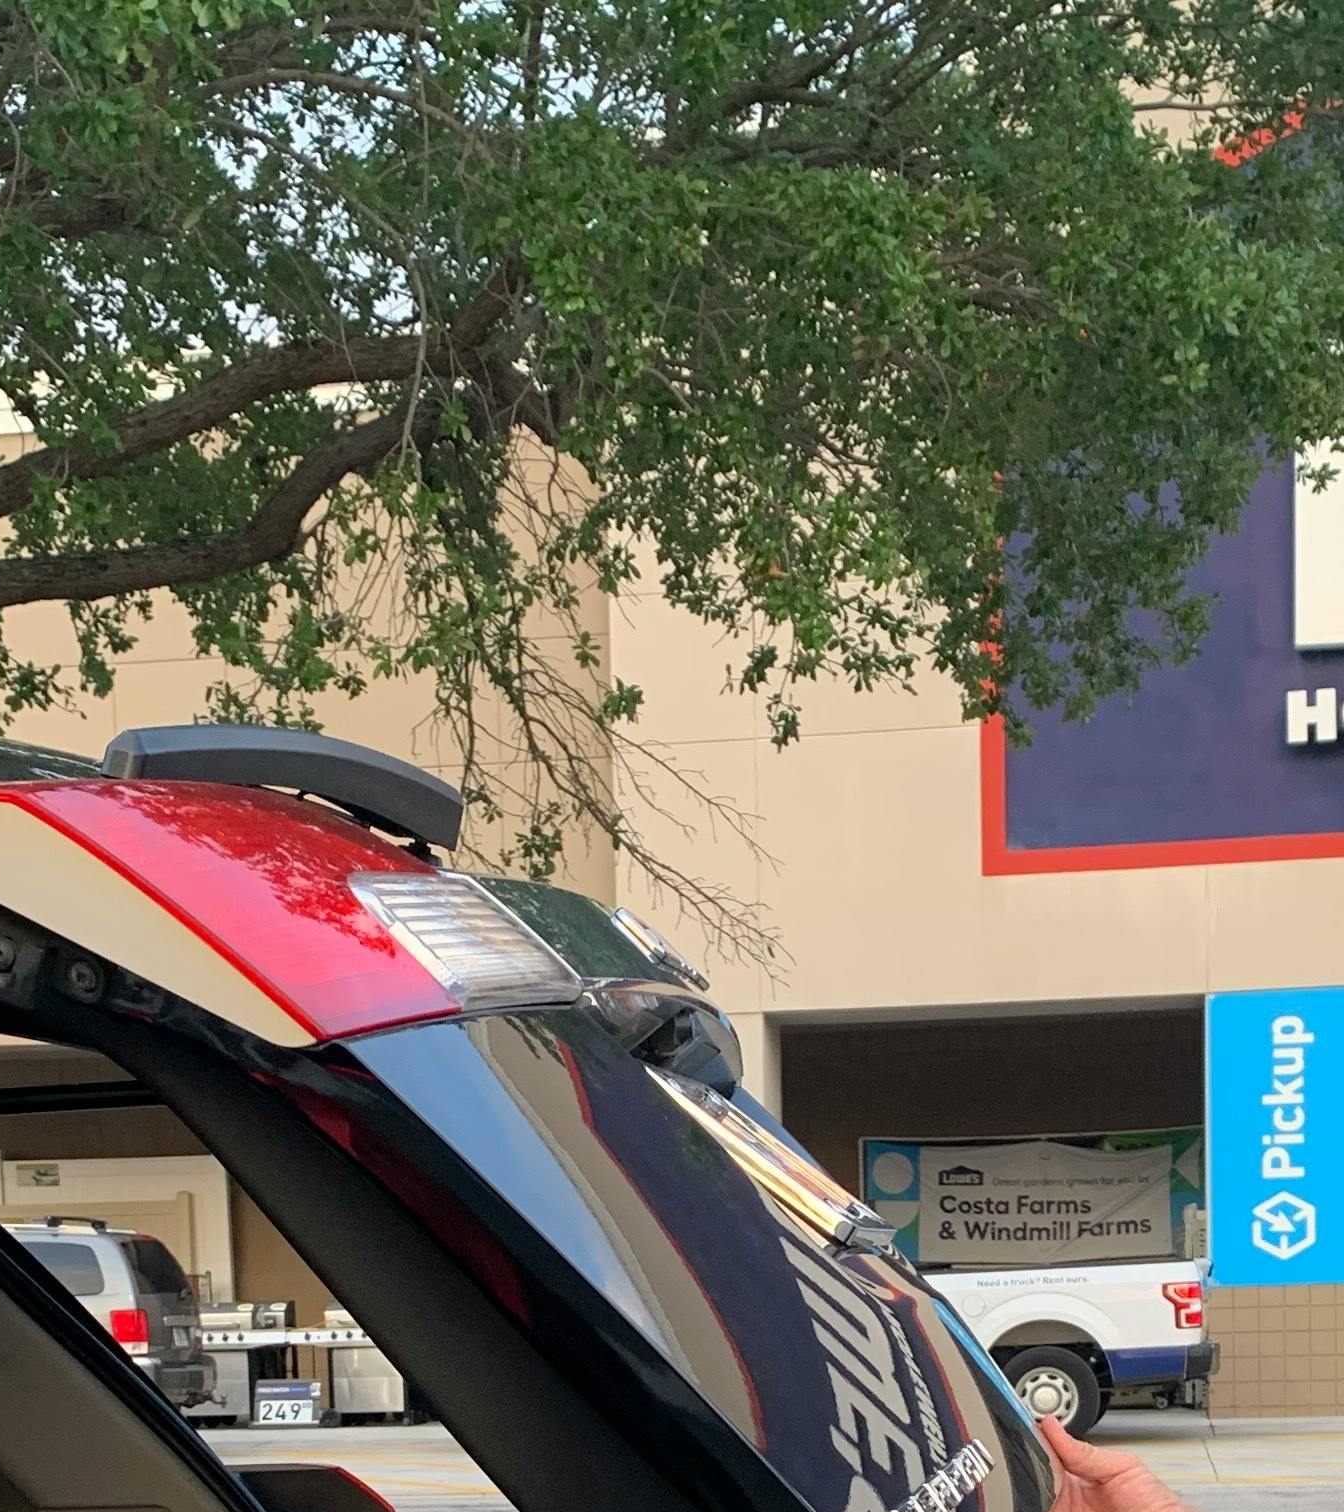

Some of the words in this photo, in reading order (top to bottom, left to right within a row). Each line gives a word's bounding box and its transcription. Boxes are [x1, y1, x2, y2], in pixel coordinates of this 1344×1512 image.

[1261, 1015, 1316, 1180] Pickup
[942, 1171, 981, 1185] LOWE'S
[939, 1194, 1010, 1215] Costa
[1016, 1194, 1092, 1216] Farms
[938, 1220, 957, 1241] &
[963, 1221, 1071, 1242] Windmill
[1077, 1217, 1152, 1239] Farms
[977, 1278, 1001, 1288] Need
[1002, 1280, 1009, 1288] a
[1010, 1276, 1041, 1287] truck?
[262, 1402, 302, 1421] 249
